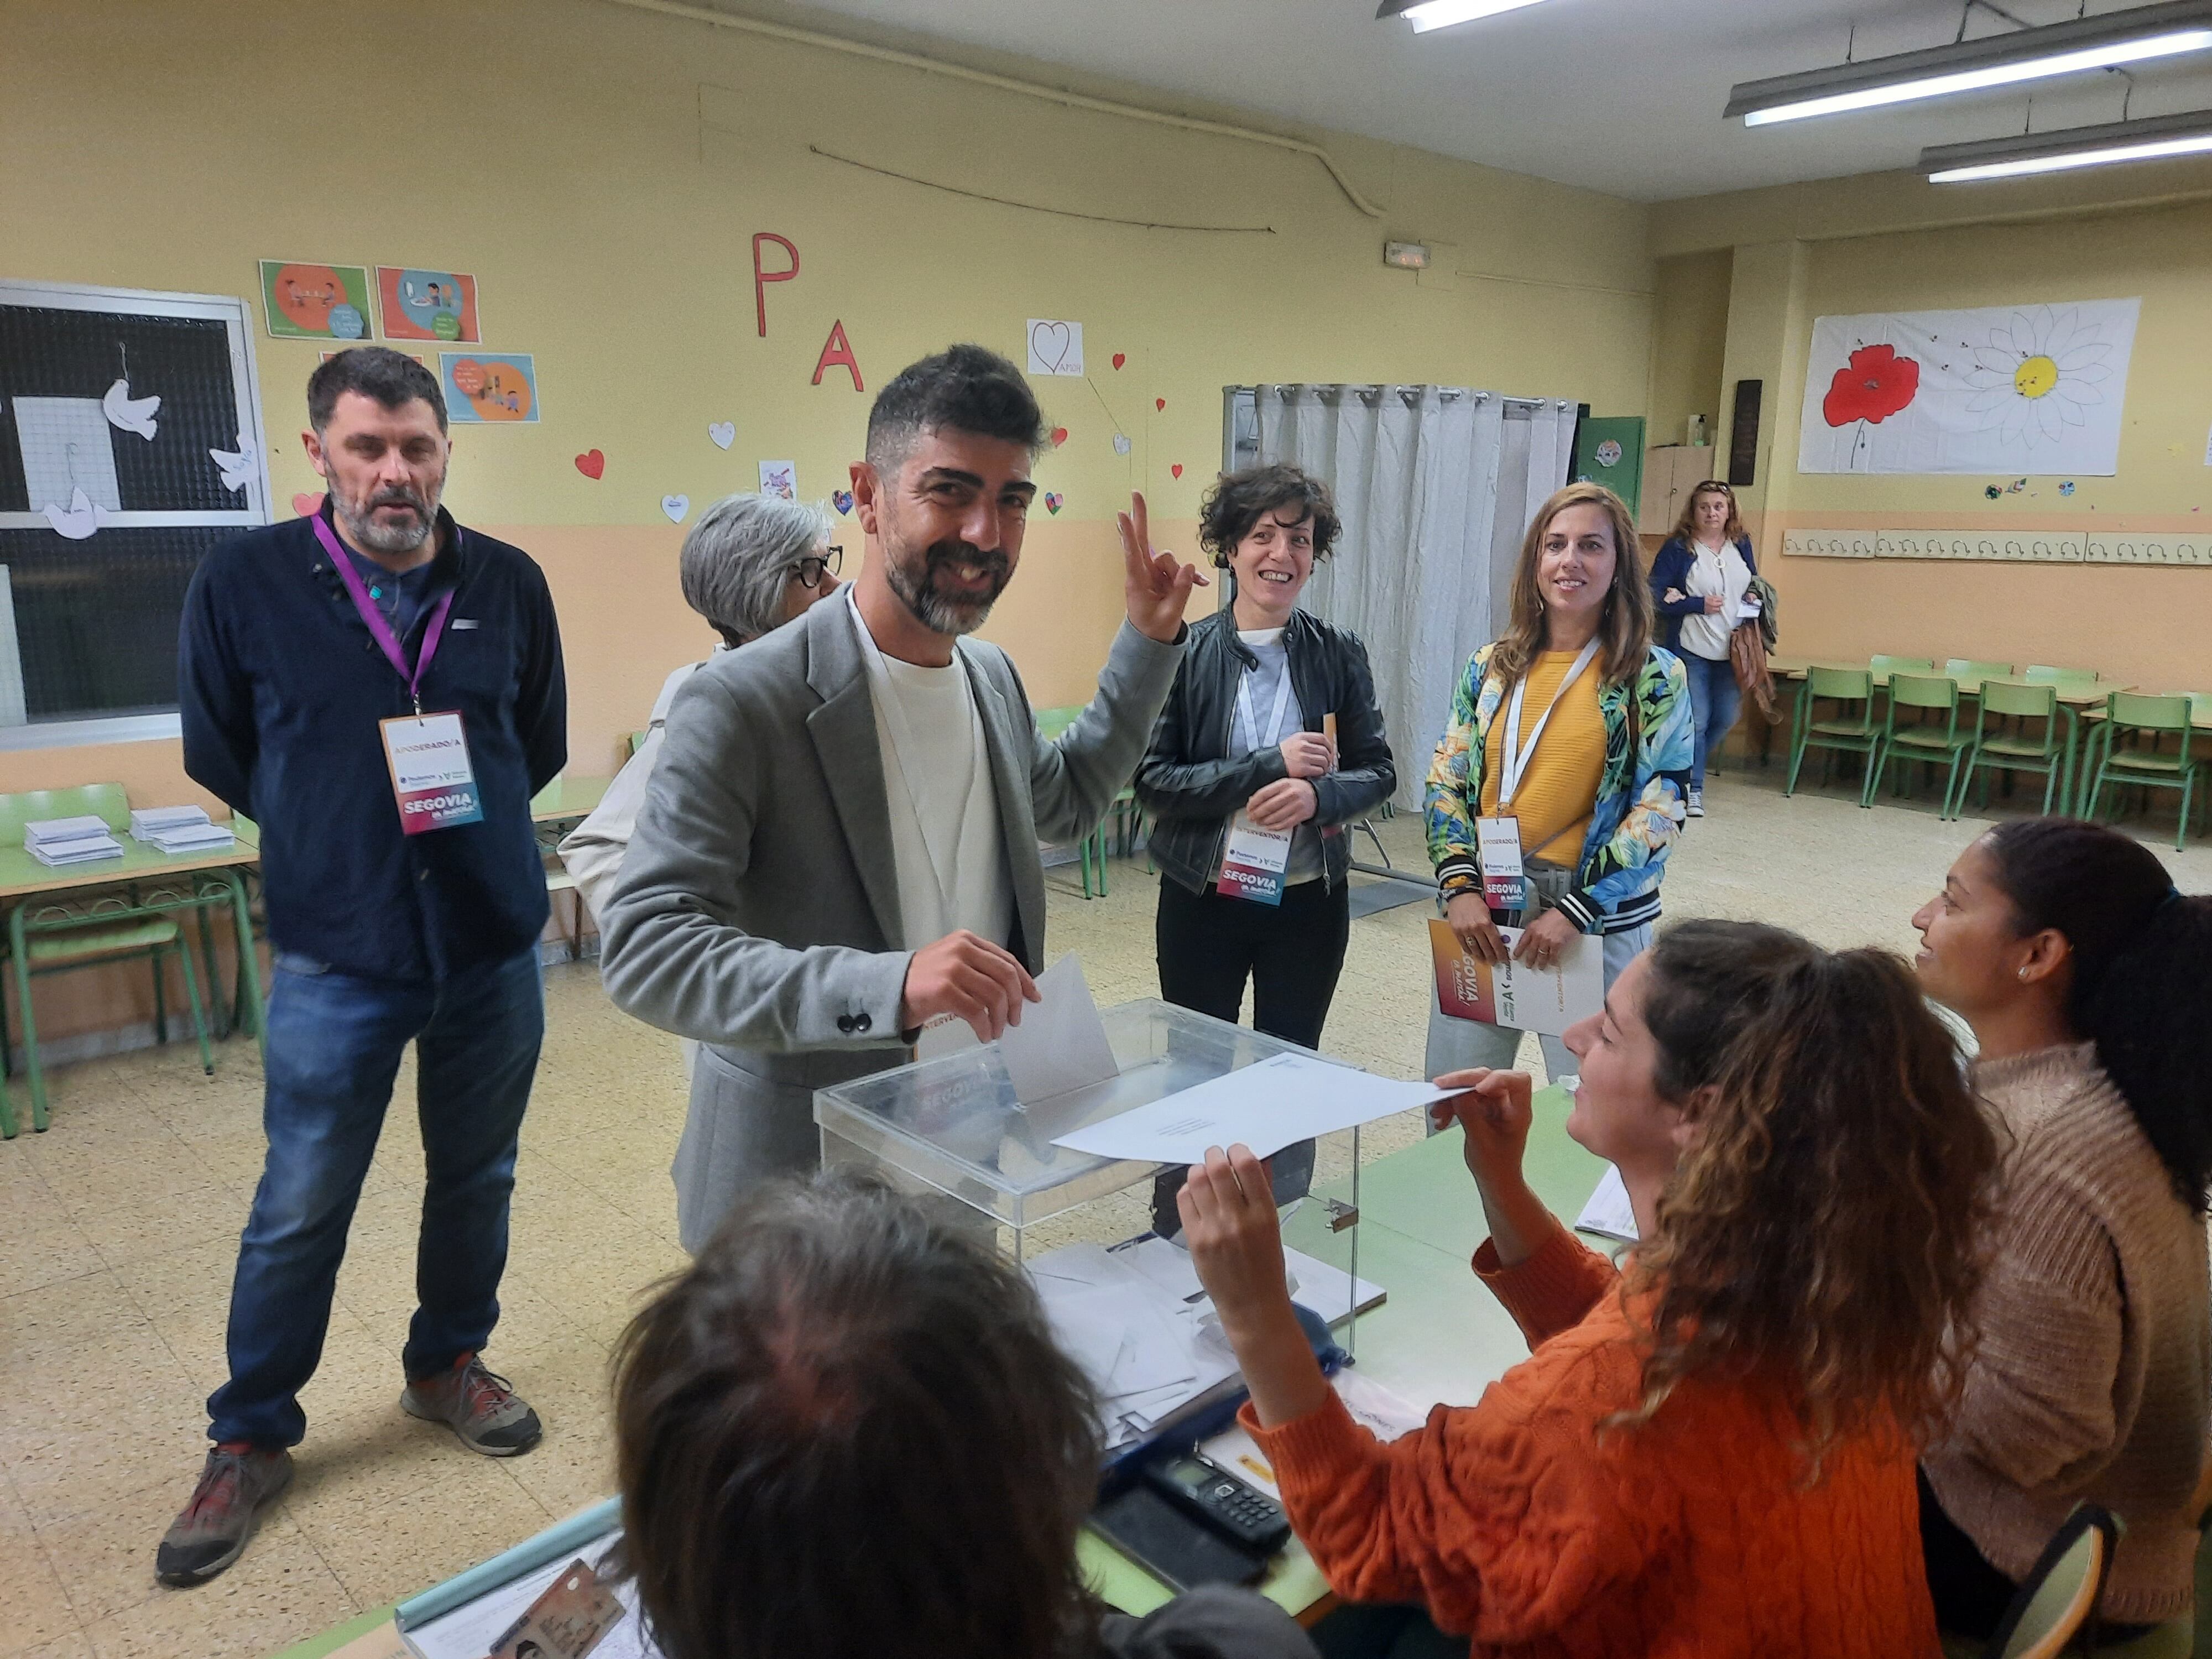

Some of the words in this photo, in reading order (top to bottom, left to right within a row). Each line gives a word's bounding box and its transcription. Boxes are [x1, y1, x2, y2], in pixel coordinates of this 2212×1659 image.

[753, 232, 800, 337] P
[811, 319, 864, 393] A
[404, 792, 472, 814] SEGOVIA
[1223, 869, 1276, 890] SEGOVIA
[1486, 883, 1522, 894] SEGOVIA
[1462, 949, 1479, 1002] GOVIA
